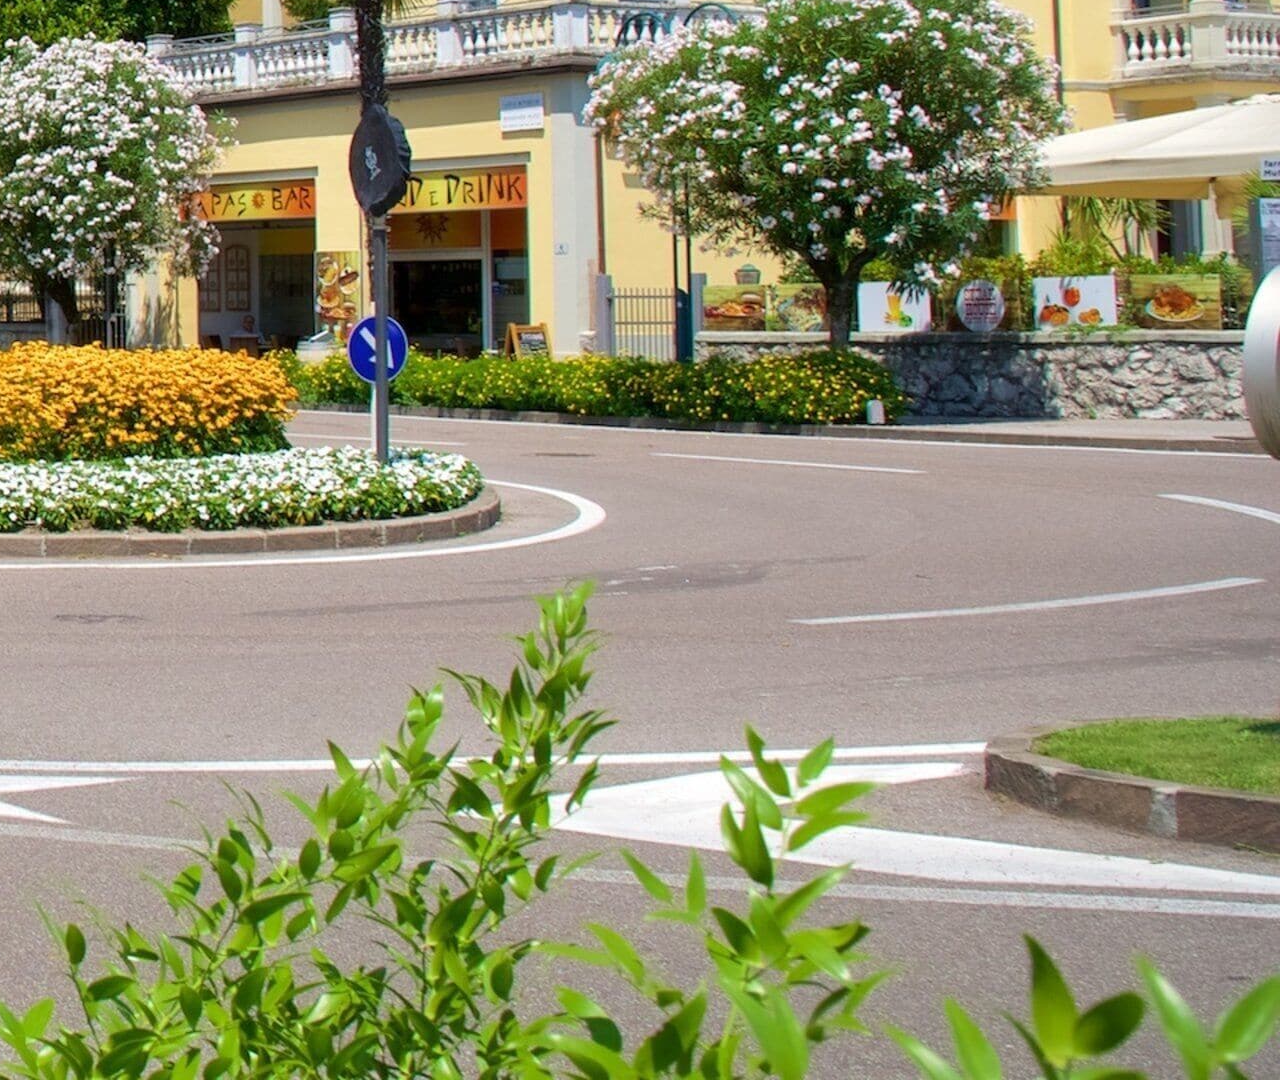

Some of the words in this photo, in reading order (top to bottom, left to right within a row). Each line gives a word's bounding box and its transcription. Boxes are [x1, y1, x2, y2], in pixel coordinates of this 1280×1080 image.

[185, 191, 247, 218] APAS
[271, 186, 312, 211] BAR
[443, 172, 523, 205] DRINK
